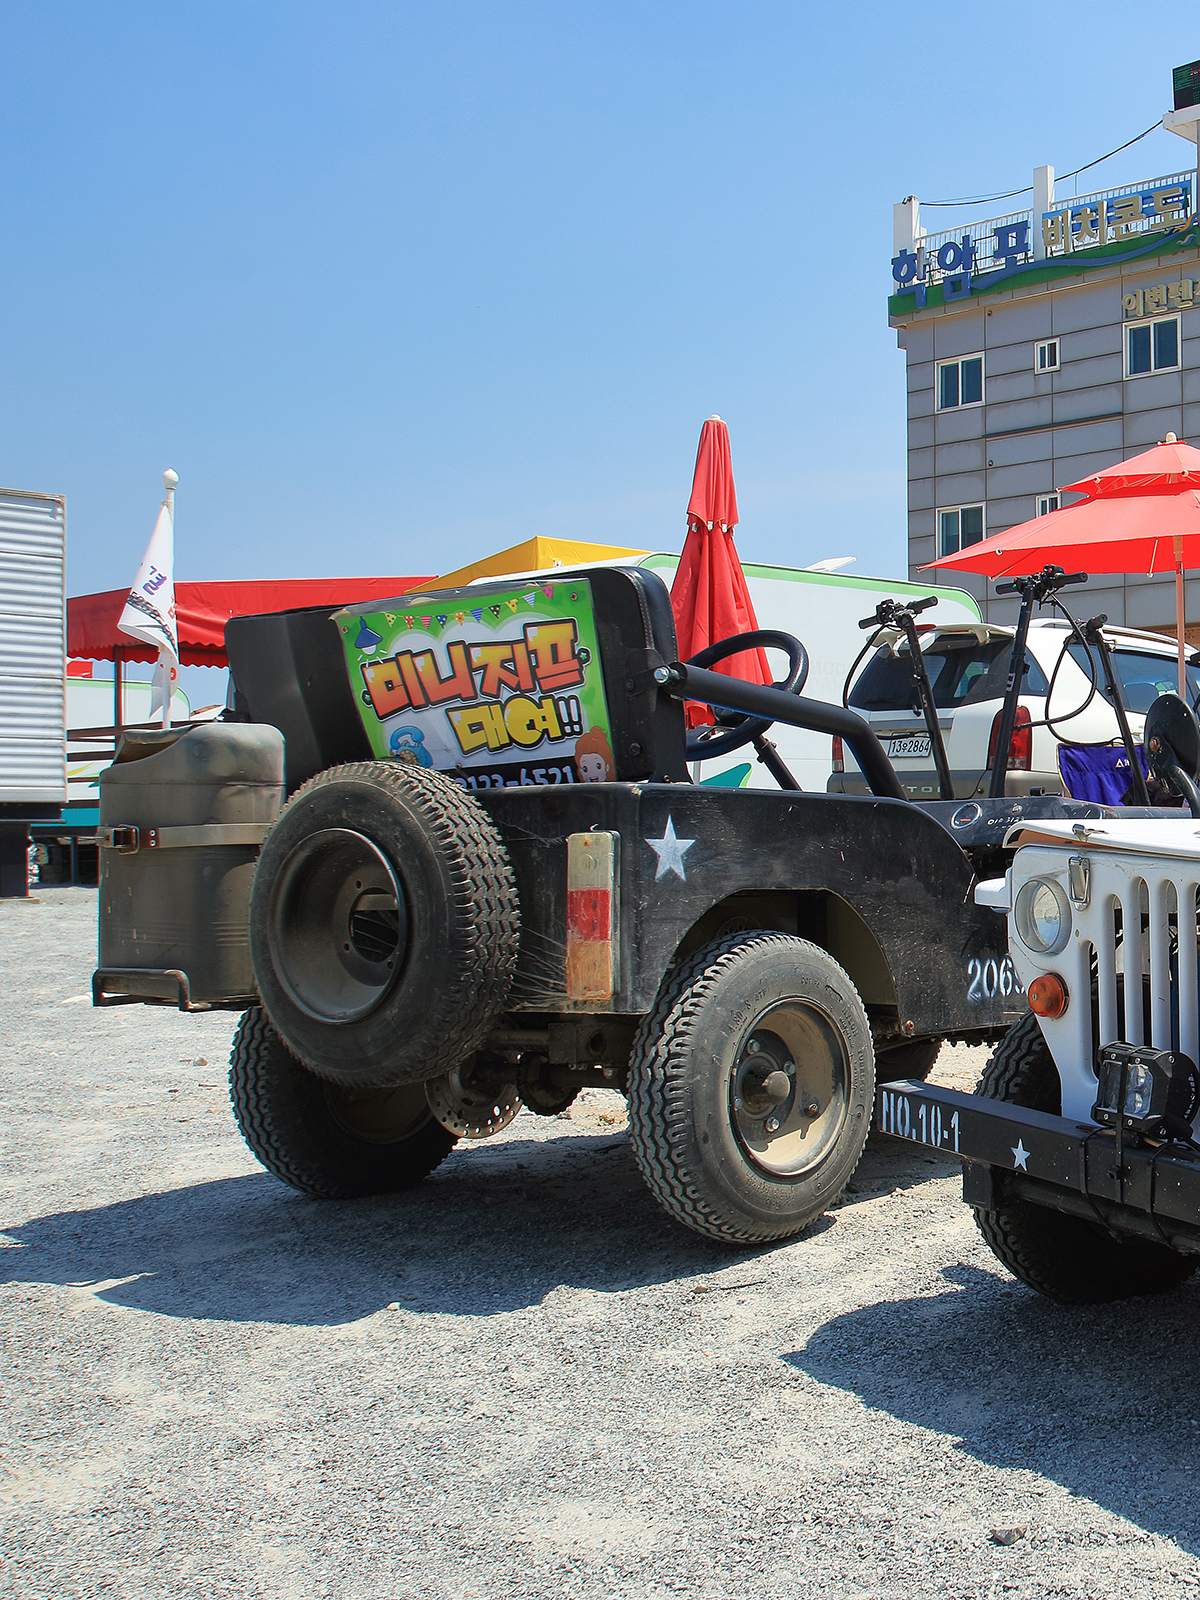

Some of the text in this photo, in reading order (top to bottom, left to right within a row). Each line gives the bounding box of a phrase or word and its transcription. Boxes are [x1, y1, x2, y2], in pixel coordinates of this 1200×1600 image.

[891, 186, 1185, 308] 학암포 비치콘도
[361, 617, 586, 721] 미니지프
[445, 694, 584, 755] 대여!!
[882, 1091, 959, 1153] NO.10-1
